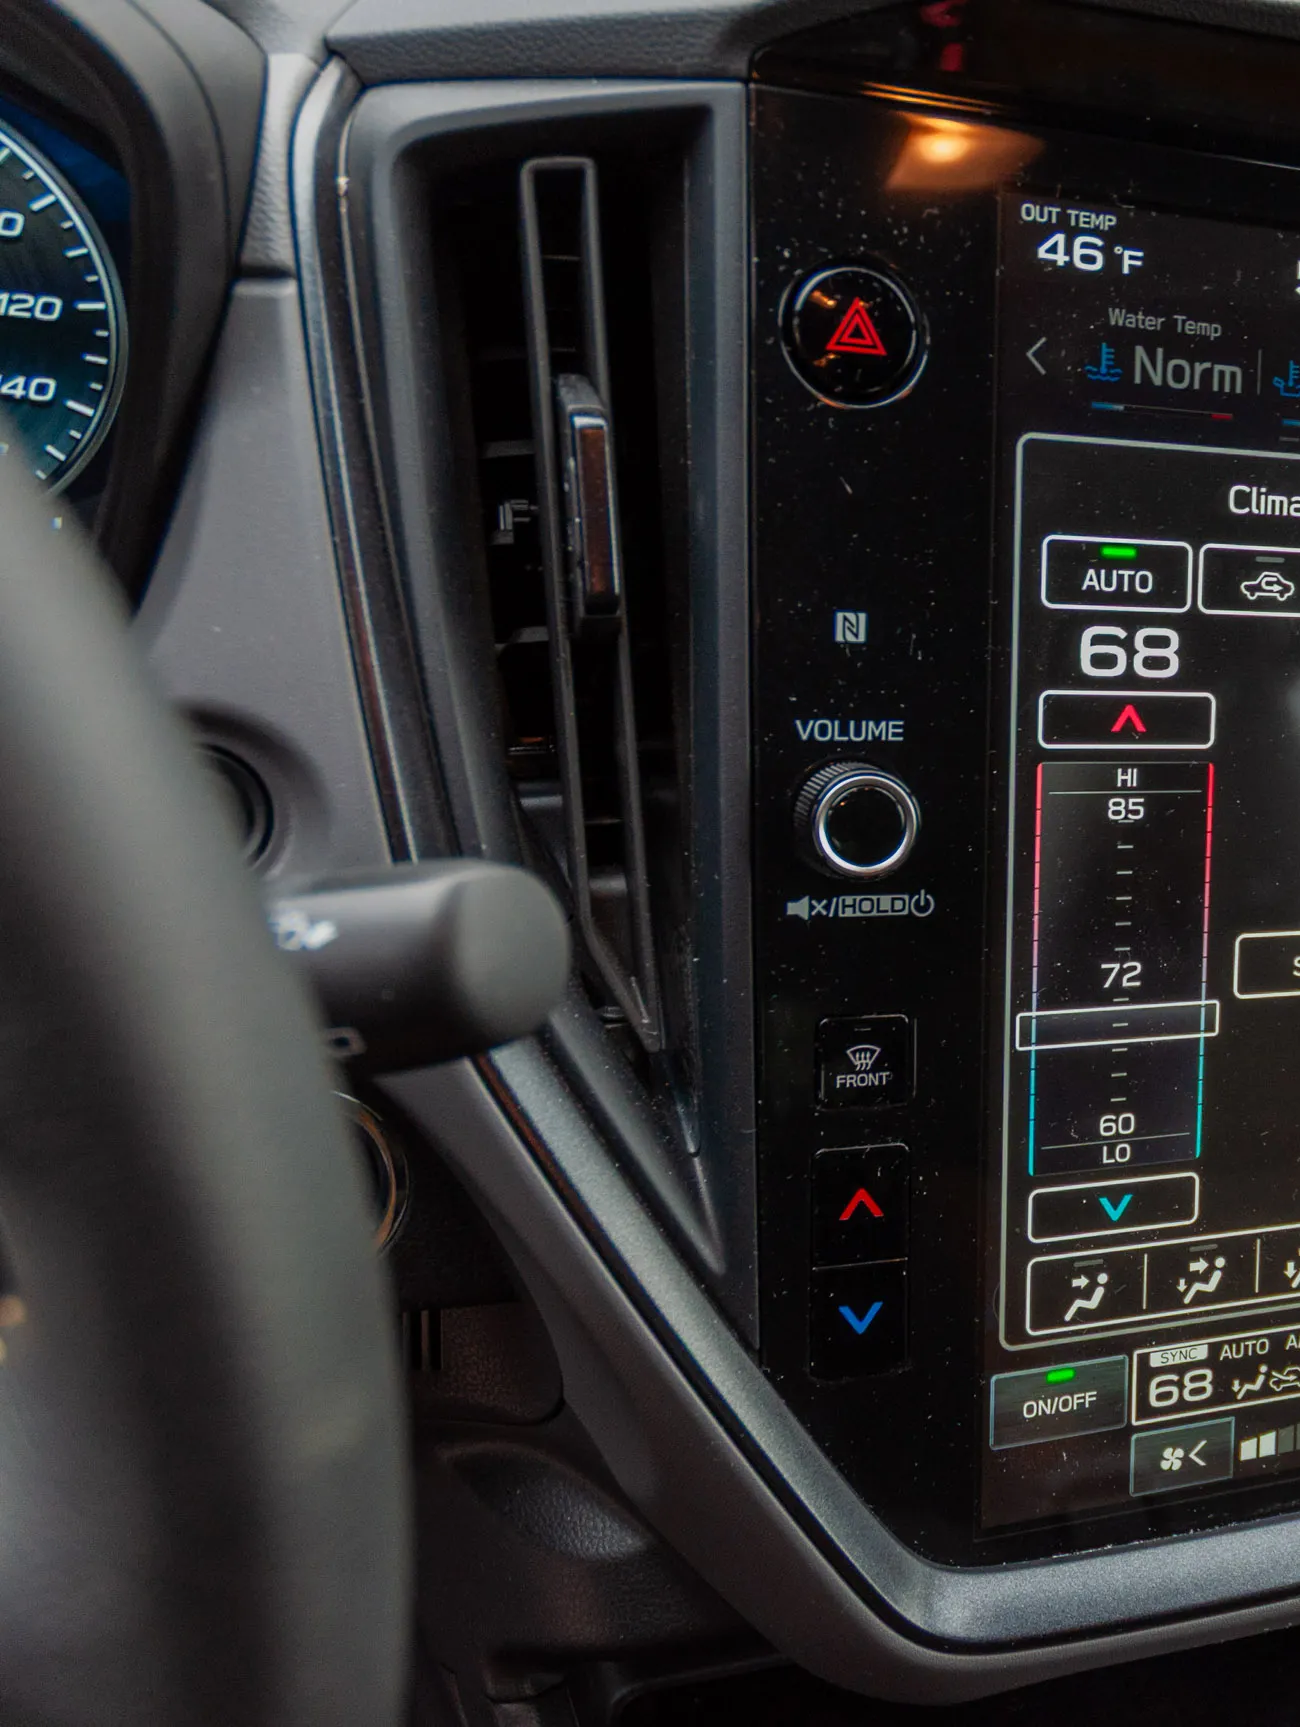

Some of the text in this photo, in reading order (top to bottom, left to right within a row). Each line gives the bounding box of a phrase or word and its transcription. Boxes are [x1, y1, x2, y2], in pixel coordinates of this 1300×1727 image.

[1020, 203, 1117, 230] OUT TEMP
[1037, 233, 1105, 271] 46
[1108, 307, 1222, 341] Water Temp
[1133, 344, 1243, 394] Norm
[0, 373, 57, 402] 40
[1082, 569, 1153, 593] AUTO
[1079, 626, 1180, 678] 68
[796, 719, 904, 742] VOLUME
[1117, 768, 1138, 787] HI
[1107, 797, 1145, 821] 85
[1100, 963, 1142, 988] 72
[836, 1072, 890, 1088] FRONT
[1100, 1113, 1136, 1137] 60
[1102, 1144, 1131, 1164] LO
[1159, 1346, 1199, 1365] SYNC
[1219, 1338, 1270, 1360] AUTO
[1148, 1367, 1214, 1408] 68
[1023, 1391, 1097, 1418] ON/OFF
